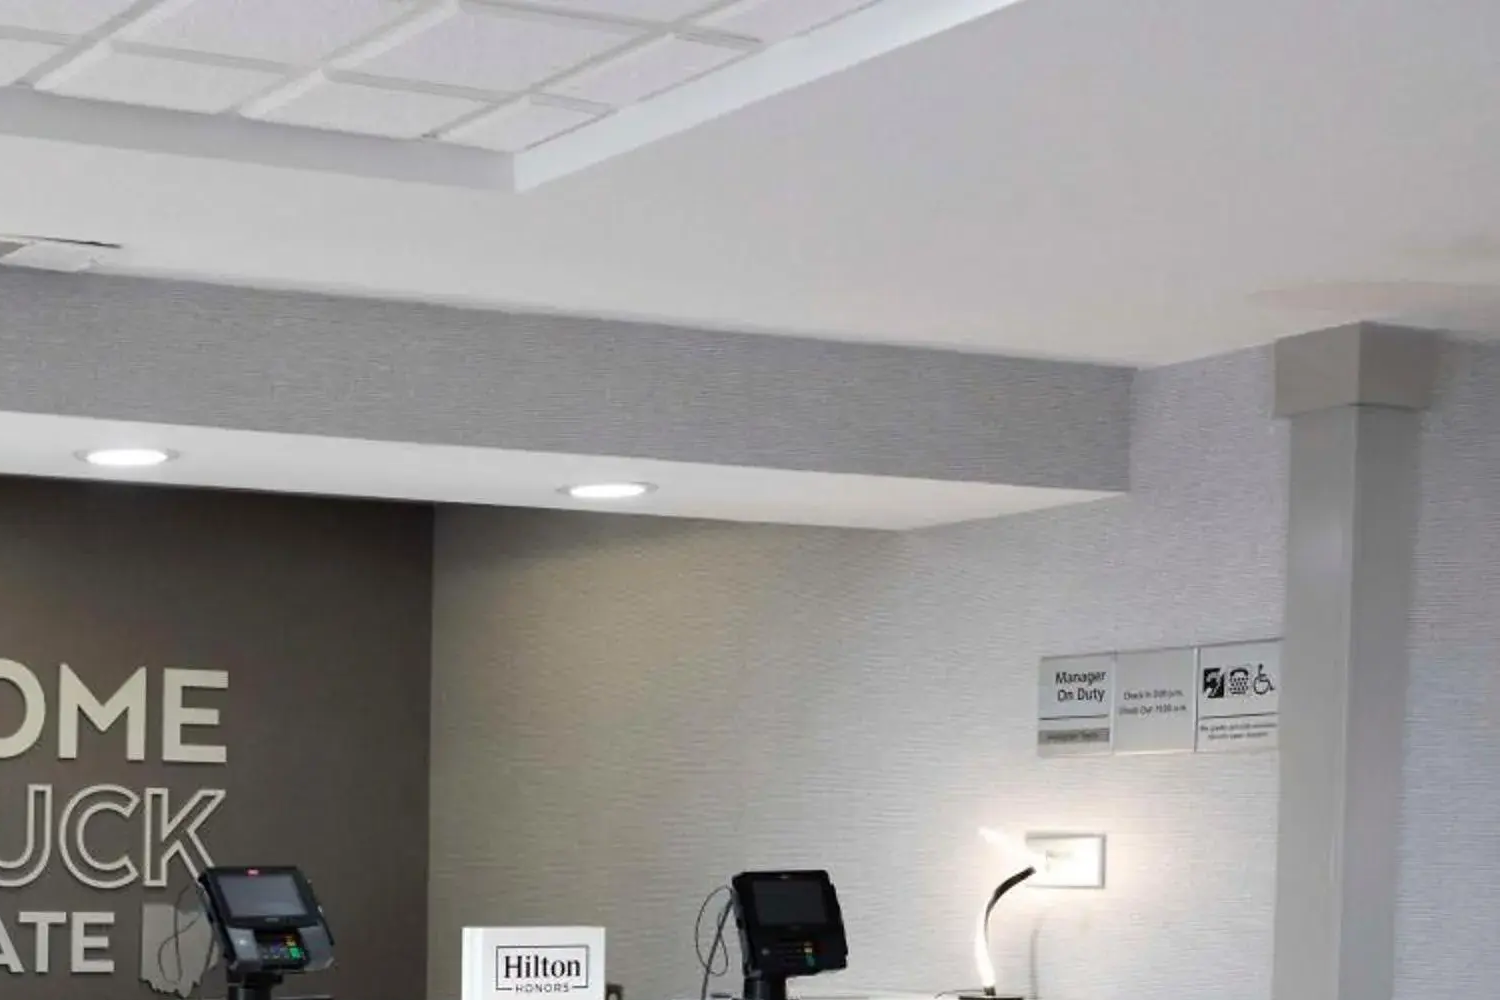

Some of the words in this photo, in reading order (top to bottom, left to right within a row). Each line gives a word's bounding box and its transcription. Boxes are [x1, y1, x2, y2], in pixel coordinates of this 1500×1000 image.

[1056, 671, 1107, 686] Manager
[1058, 688, 1074, 702] On
[1078, 687, 1106, 702] Duty
[504, 955, 581, 979] Hilton
[515, 983, 570, 994] HONORS
